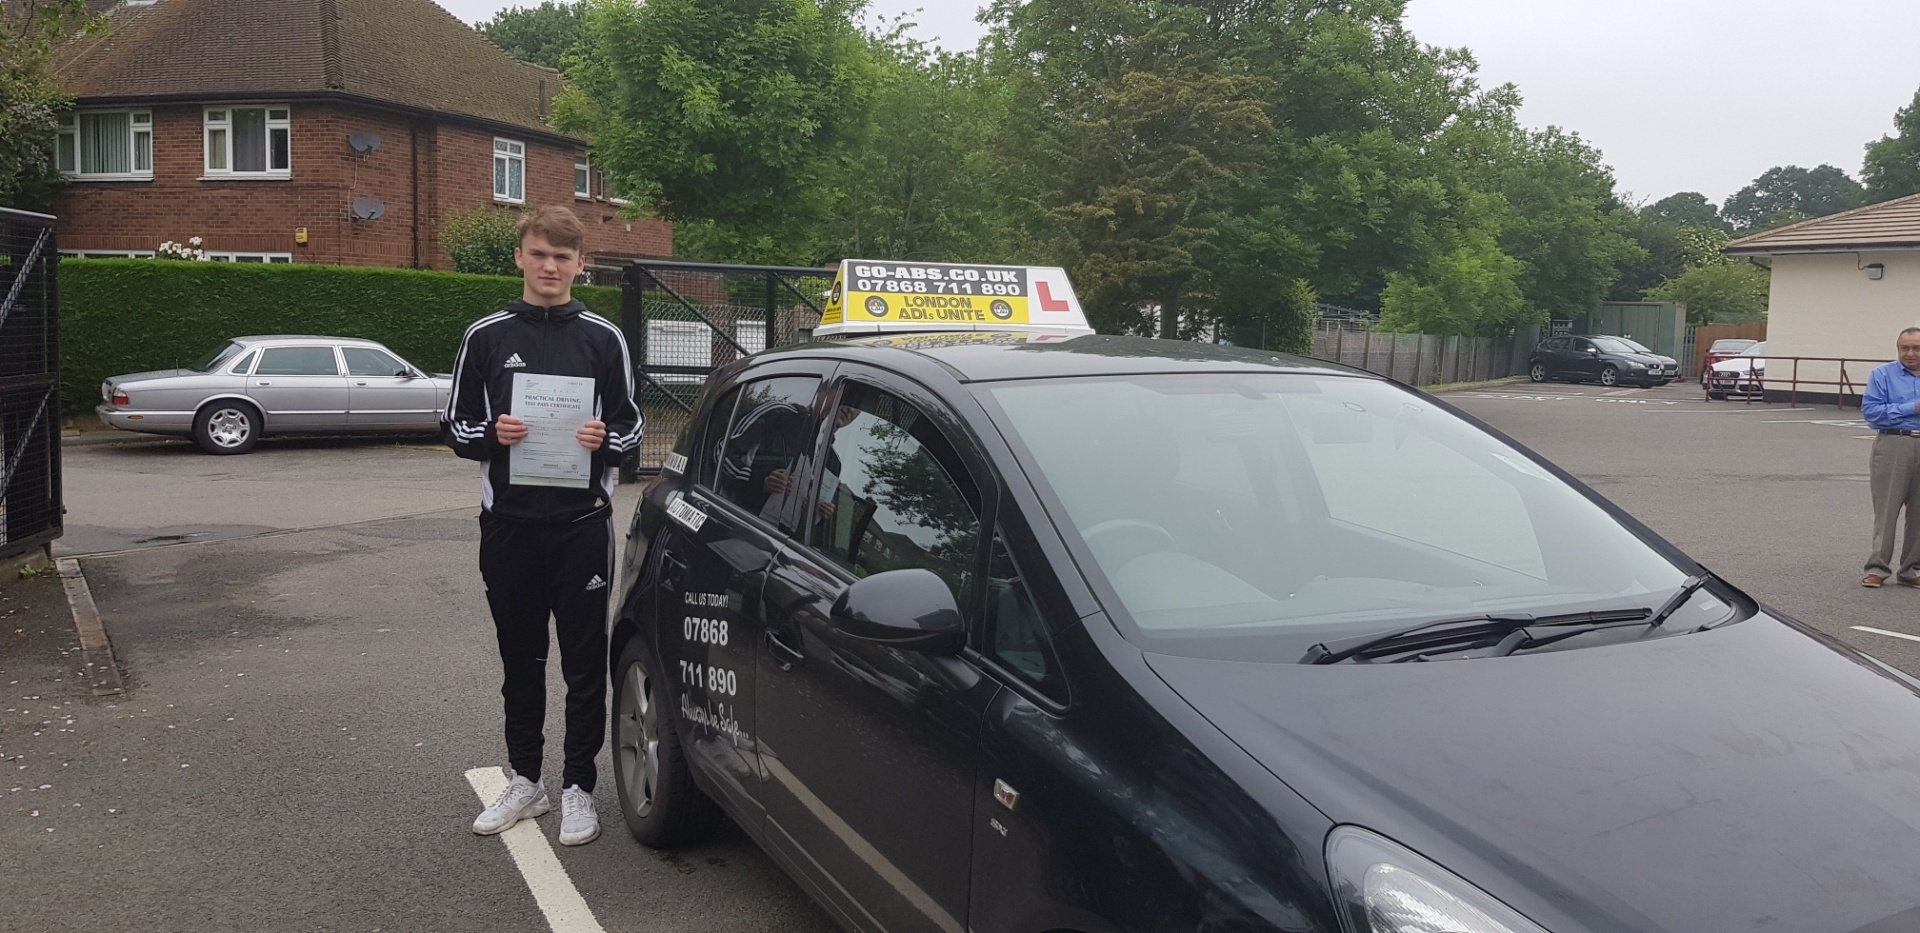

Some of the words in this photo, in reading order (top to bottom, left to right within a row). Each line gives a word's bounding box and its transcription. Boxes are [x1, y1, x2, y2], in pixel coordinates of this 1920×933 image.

[855, 265, 1018, 282] GO-ABS.CO.UK
[857, 279, 927, 293] 07868
[933, 282, 972, 294] 711
[981, 284, 1020, 296] 890
[1035, 281, 1070, 311] L
[904, 296, 972, 309] LONDON
[936, 309, 985, 321] UNITE
[556, 396, 582, 404] DRIVING
[668, 499, 706, 531] AUTOMATIC
[685, 592, 698, 604] CALL
[698, 594, 707, 606] US
[707, 594, 729, 608] TODAY!
[684, 616, 729, 646] 07868
[679, 660, 703, 688] 711
[708, 666, 737, 696] 890
[681, 693, 711, 735] Always
